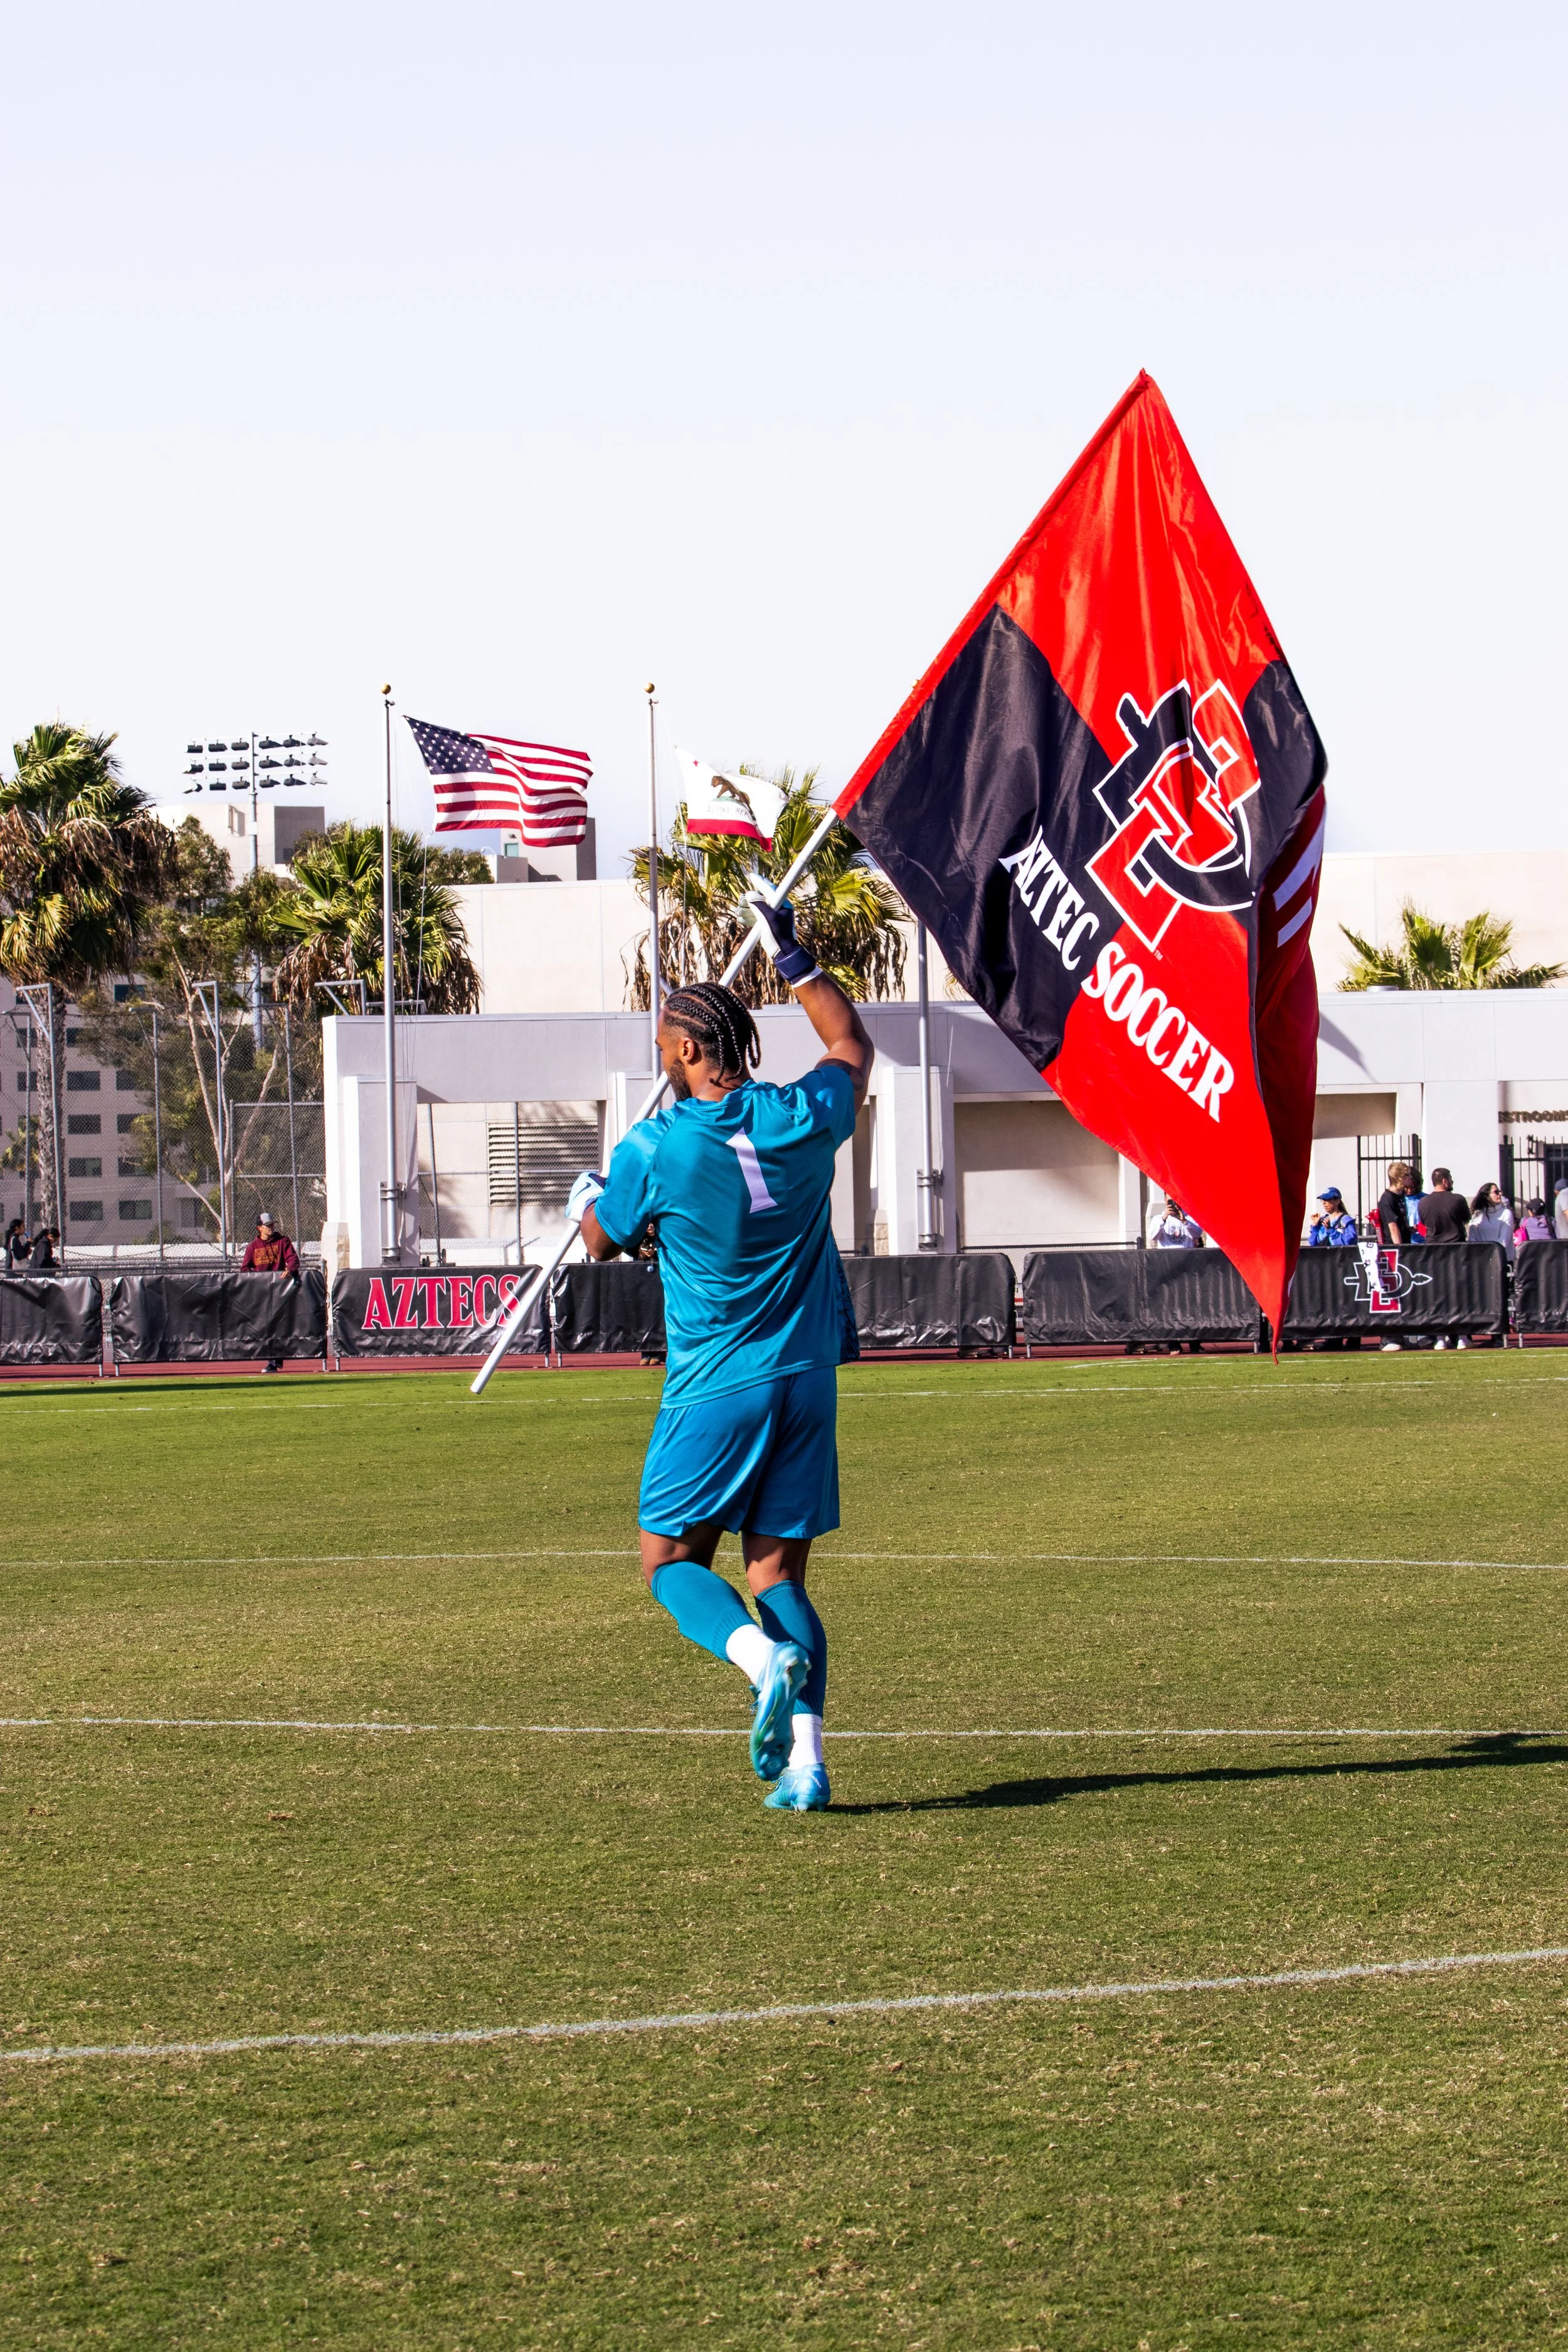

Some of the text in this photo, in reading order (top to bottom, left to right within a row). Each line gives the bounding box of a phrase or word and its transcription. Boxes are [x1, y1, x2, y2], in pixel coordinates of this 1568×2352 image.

[999, 825, 1235, 1123] AZTEC SOCCER
[725, 1126, 778, 1214] 1
[361, 1274, 521, 1329] AZTECS
